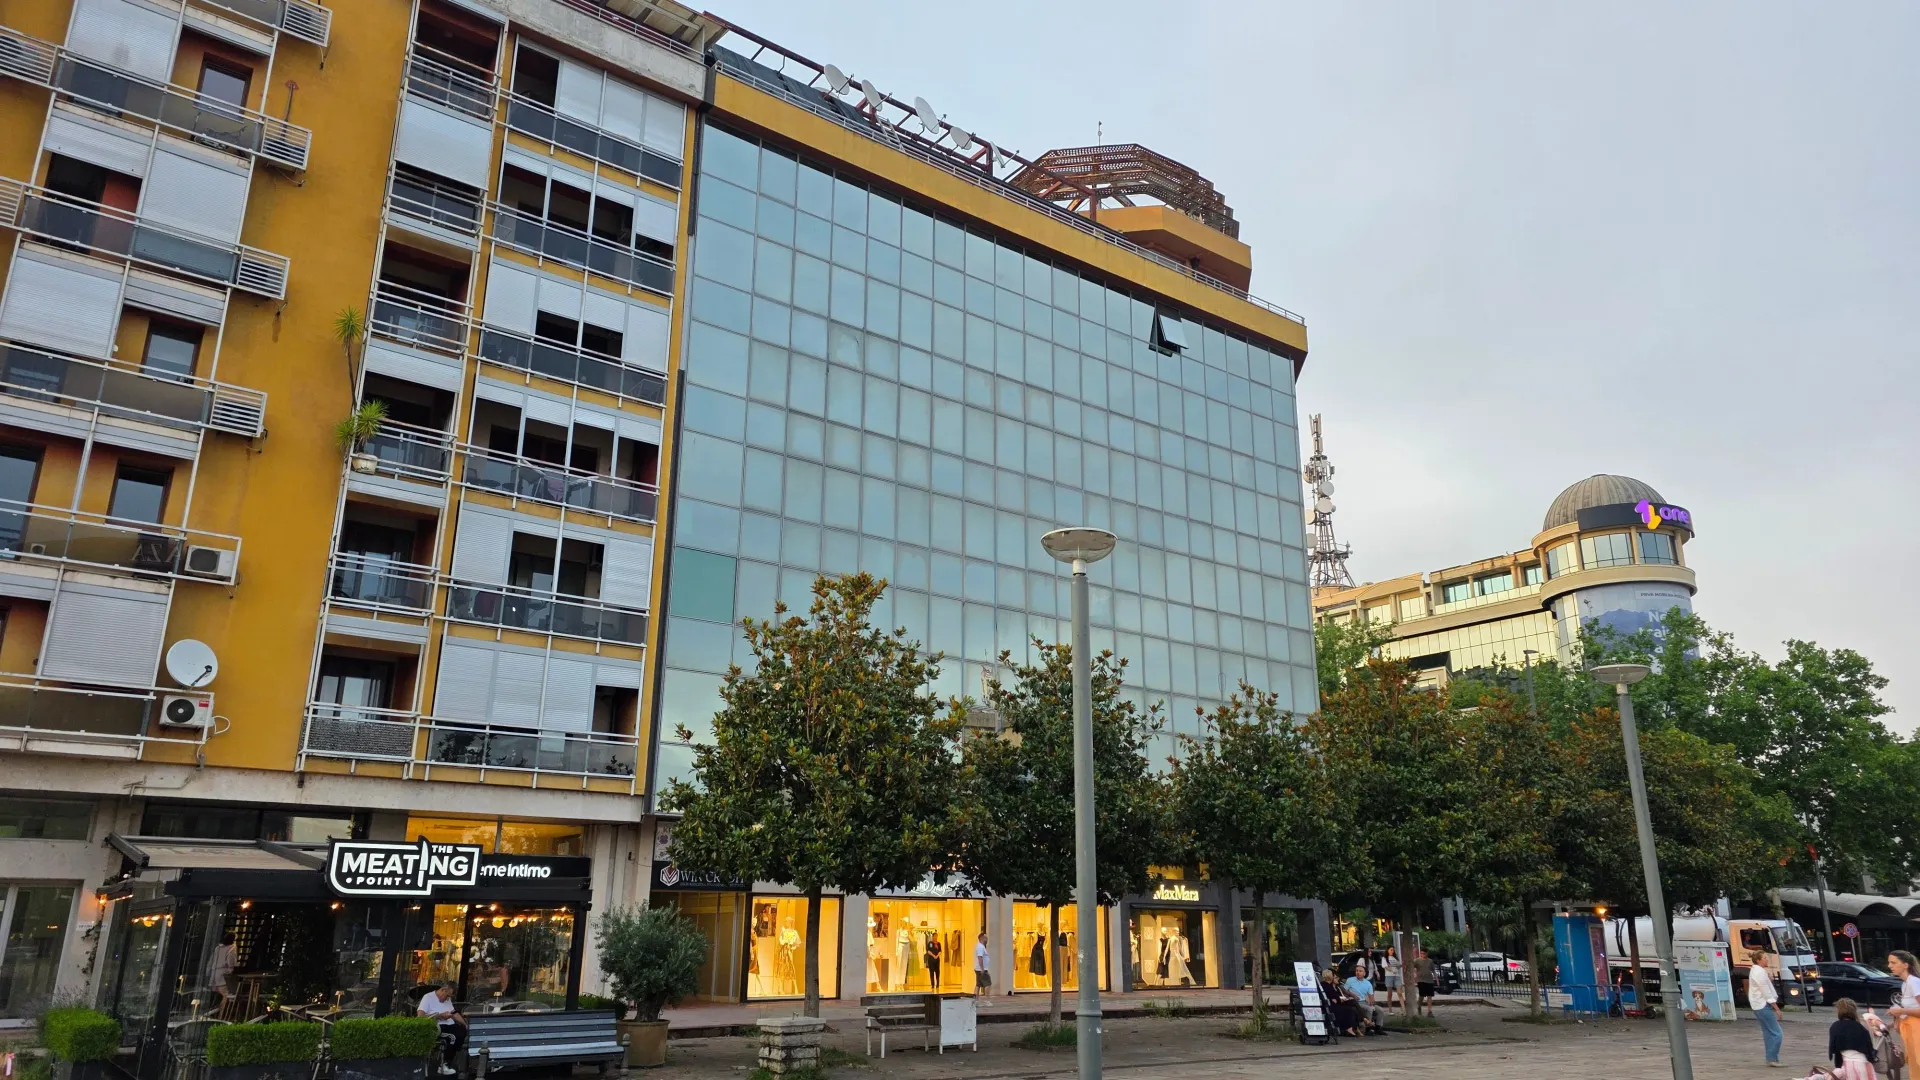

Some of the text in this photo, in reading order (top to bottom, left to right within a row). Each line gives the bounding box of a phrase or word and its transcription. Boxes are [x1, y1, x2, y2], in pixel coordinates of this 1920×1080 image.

[1660, 506, 1689, 524] one
[432, 845, 453, 853] THE
[341, 852, 469, 876] MEATING
[356, 876, 402, 886] POINT
[1153, 884, 1199, 901] MaxMara
